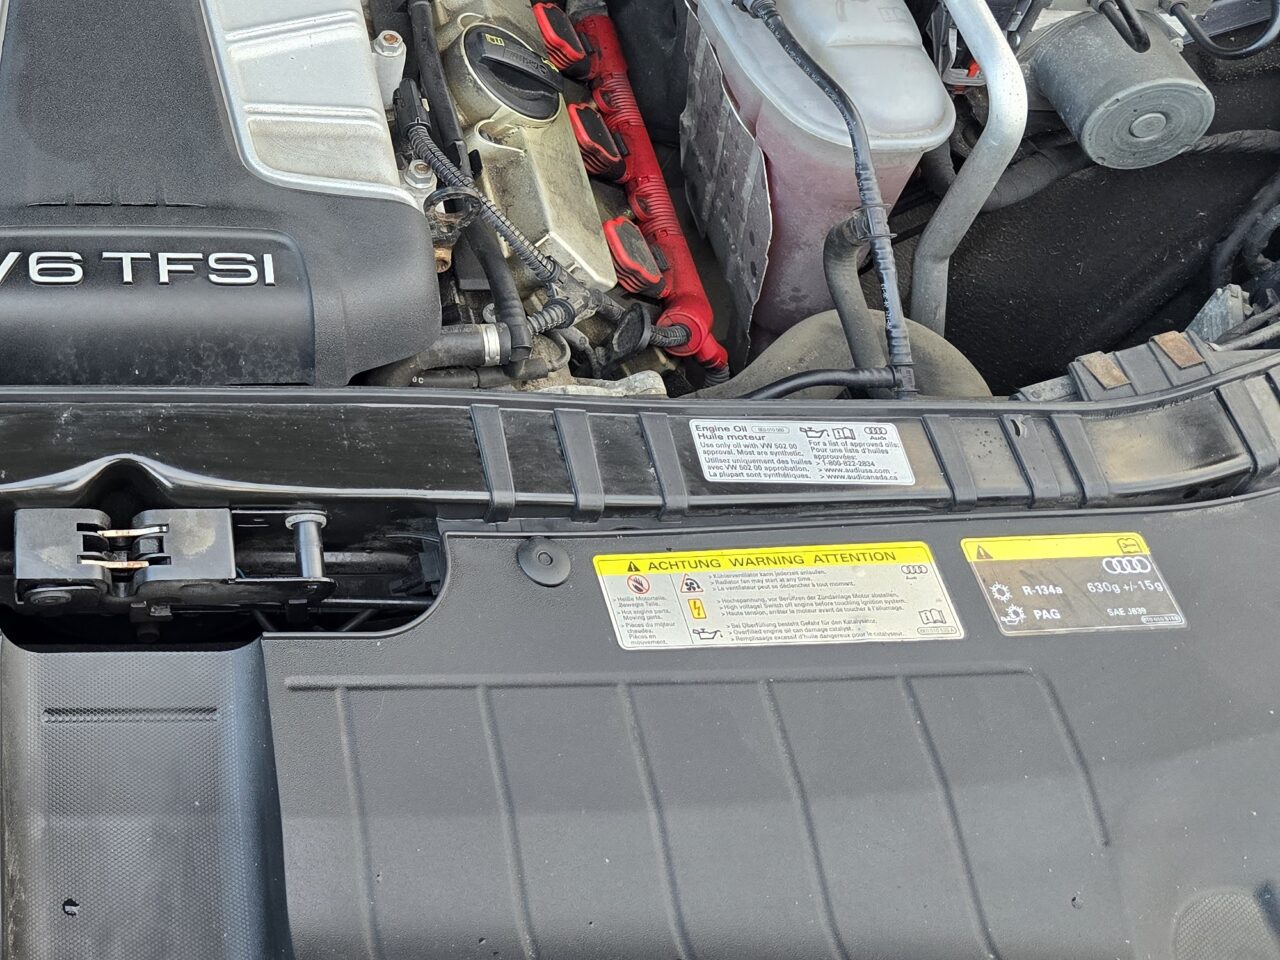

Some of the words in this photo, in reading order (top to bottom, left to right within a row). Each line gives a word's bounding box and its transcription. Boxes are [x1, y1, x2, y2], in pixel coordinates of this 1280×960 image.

[102, 251, 276, 286] TFSI
[694, 424, 730, 433] Engine
[647, 558, 721, 570] ACHTUNG
[730, 555, 804, 566] WARNING
[813, 551, 896, 563] ATTENTION
[1023, 584, 1063, 595] R-134a
[1087, 581, 1121, 594] 630g
[1034, 608, 1062, 619] PAG
[1126, 606, 1147, 615] J639
